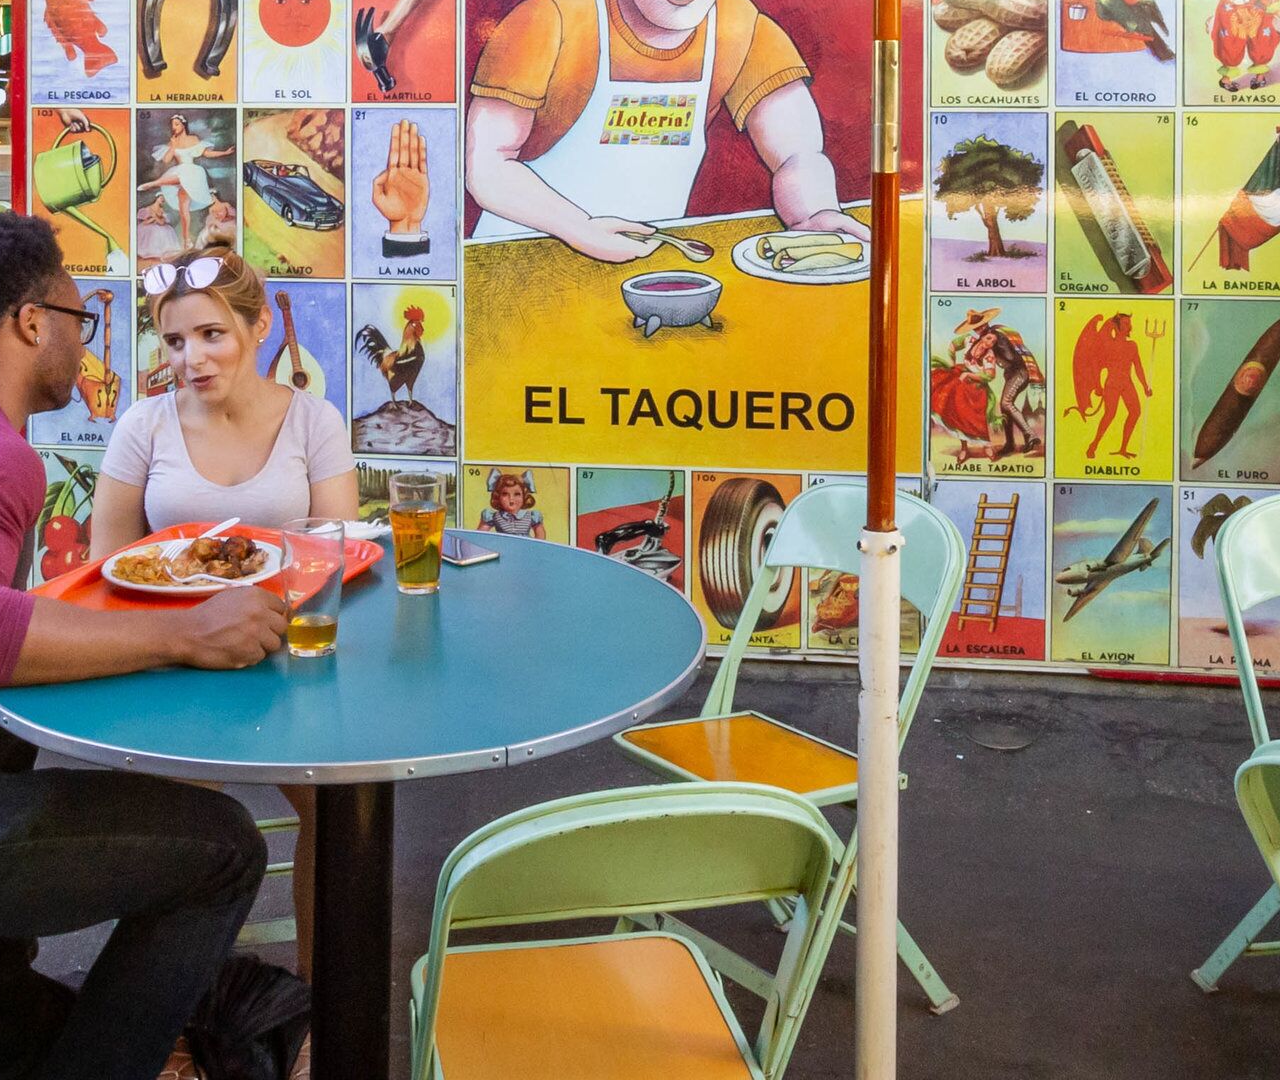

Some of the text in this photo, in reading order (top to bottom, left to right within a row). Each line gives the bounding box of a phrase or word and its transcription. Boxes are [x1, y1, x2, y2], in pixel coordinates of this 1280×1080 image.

[48, 90, 111, 100] EL PESCADO
[150, 92, 224, 102] LA HERRADURA
[275, 89, 312, 99] EL SOL
[367, 91, 432, 101] EL MARTILLO
[1076, 92, 1157, 103] EL COTORRO
[1213, 93, 1276, 104] EL PAYASO
[940, 94, 1040, 105] LOS CACAHUATES
[36, 109, 53, 117] 103
[355, 111, 367, 120] 21
[934, 115, 948, 126] 10
[1156, 115, 1170, 125] 78
[1186, 116, 1199, 127] 16
[64, 263, 114, 274] REGADERA
[270, 265, 313, 275] EL AUTO
[378, 266, 430, 275] LA MANO
[1061, 272, 1073, 280] EL
[957, 277, 1016, 289] EL ARBOL
[1059, 282, 1109, 292] ORGANO
[1202, 279, 1280, 292] LA BANDERA
[938, 299, 952, 307] 60
[1059, 301, 1066, 312] 2
[1186, 302, 1199, 312] 77
[524, 386, 855, 432] EL TAQUERO
[61, 433, 104, 442] EL ARPA
[469, 469, 481, 477] 96
[942, 462, 1034, 474] JARABE TAPATIO
[1085, 465, 1141, 476] DIABLITO
[582, 470, 594, 480] 87
[697, 473, 716, 483] 106
[1218, 469, 1269, 480] EL PURO
[1060, 486, 1072, 496] 81
[1183, 491, 1195, 501] 51
[720, 634, 731, 642] LA
[829, 633, 841, 645] LA
[945, 644, 1026, 656] LA ESCALERA
[1082, 651, 1135, 662] EL AVION
[1210, 655, 1271, 668] LA PMA
